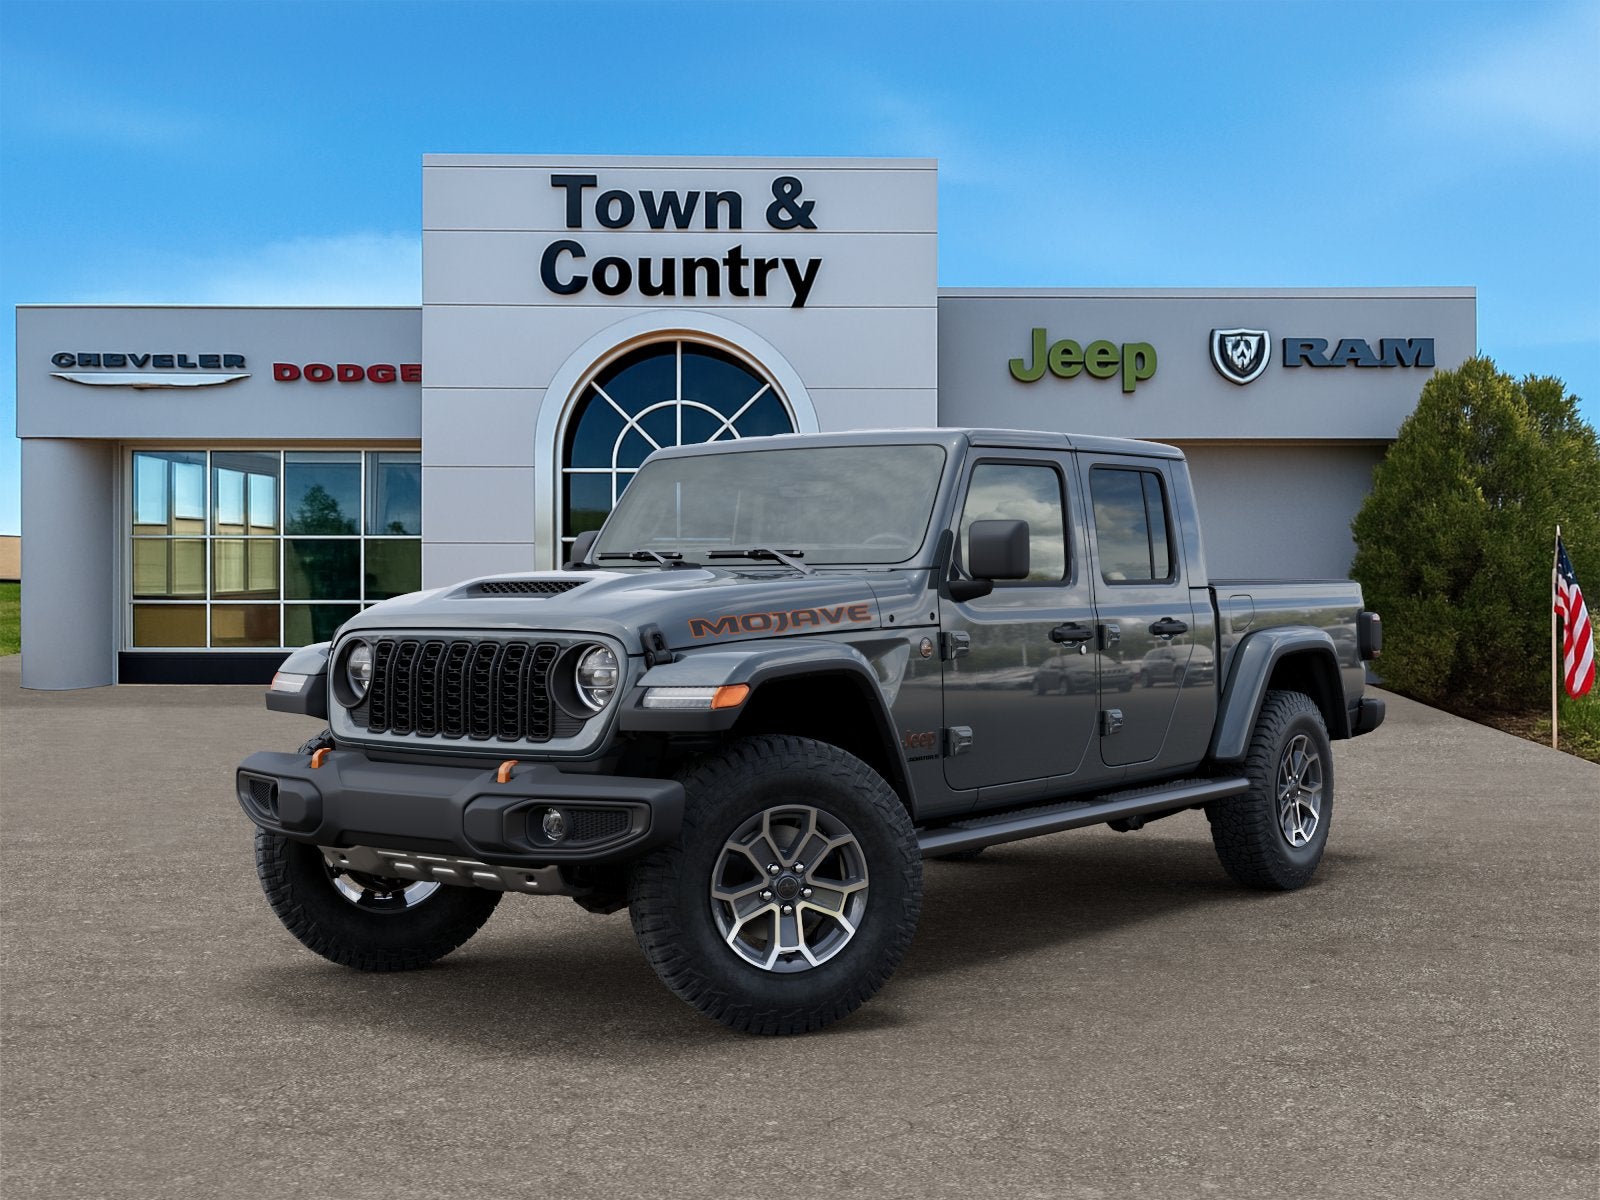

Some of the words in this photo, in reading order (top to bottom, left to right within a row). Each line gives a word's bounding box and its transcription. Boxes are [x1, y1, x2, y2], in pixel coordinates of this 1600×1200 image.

[550, 174, 743, 229] Town
[765, 175, 818, 230] &
[540, 239, 823, 309] Country
[272, 362, 422, 383] DODGE
[1008, 327, 1158, 393] Jeep
[1282, 337, 1436, 368] RAM
[688, 604, 872, 639] MOJAVE
